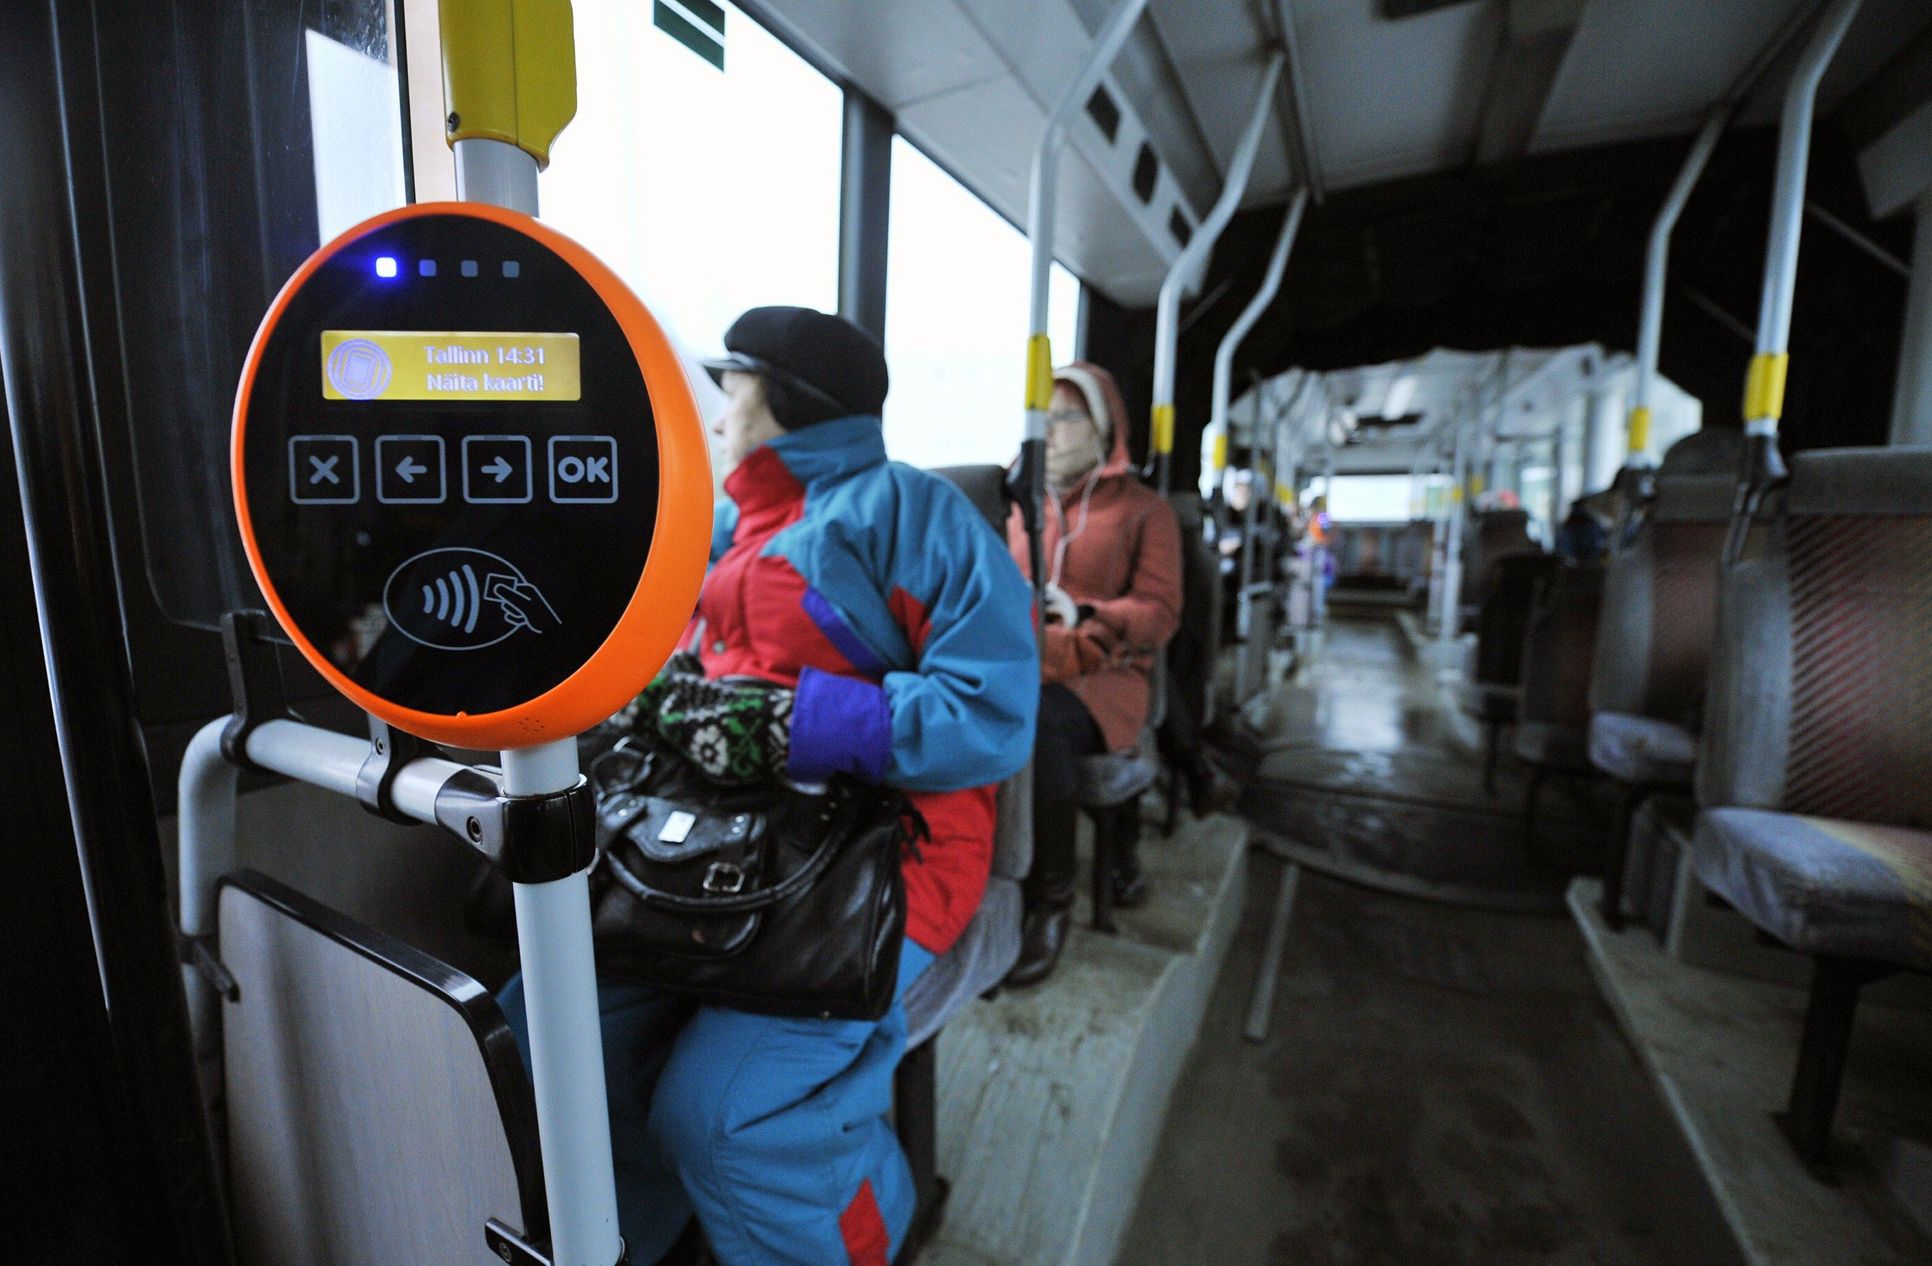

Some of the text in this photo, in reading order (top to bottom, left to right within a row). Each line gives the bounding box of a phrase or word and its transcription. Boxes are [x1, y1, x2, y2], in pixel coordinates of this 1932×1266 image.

[424, 346, 545, 366] Tallinn 14:31
[427, 373, 545, 392] Näita kaarti!
[558, 456, 611, 483] OK
